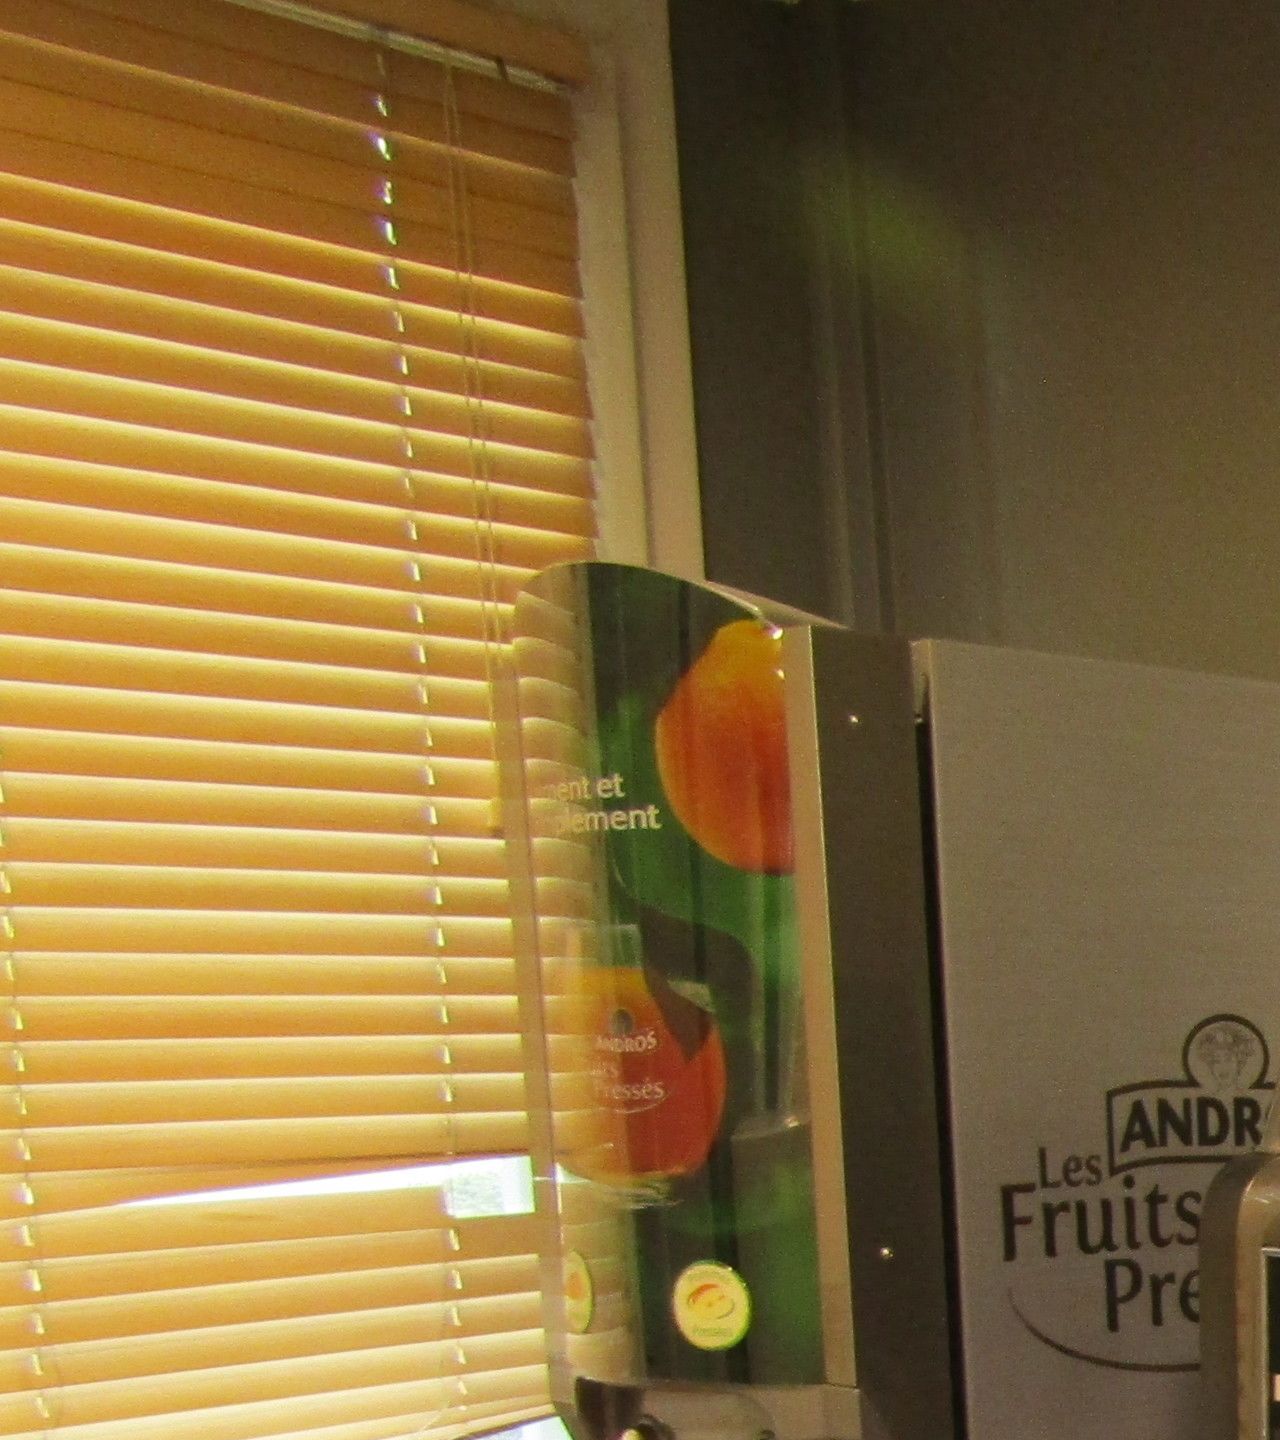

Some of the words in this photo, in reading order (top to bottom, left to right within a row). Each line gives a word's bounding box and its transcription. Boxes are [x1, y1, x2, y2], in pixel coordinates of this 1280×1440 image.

[596, 772, 625, 798] et
[1120, 1096, 1269, 1153] ANDR
[1038, 1147, 1102, 1189] Les
[1001, 1175, 1202, 1262] Fruits
